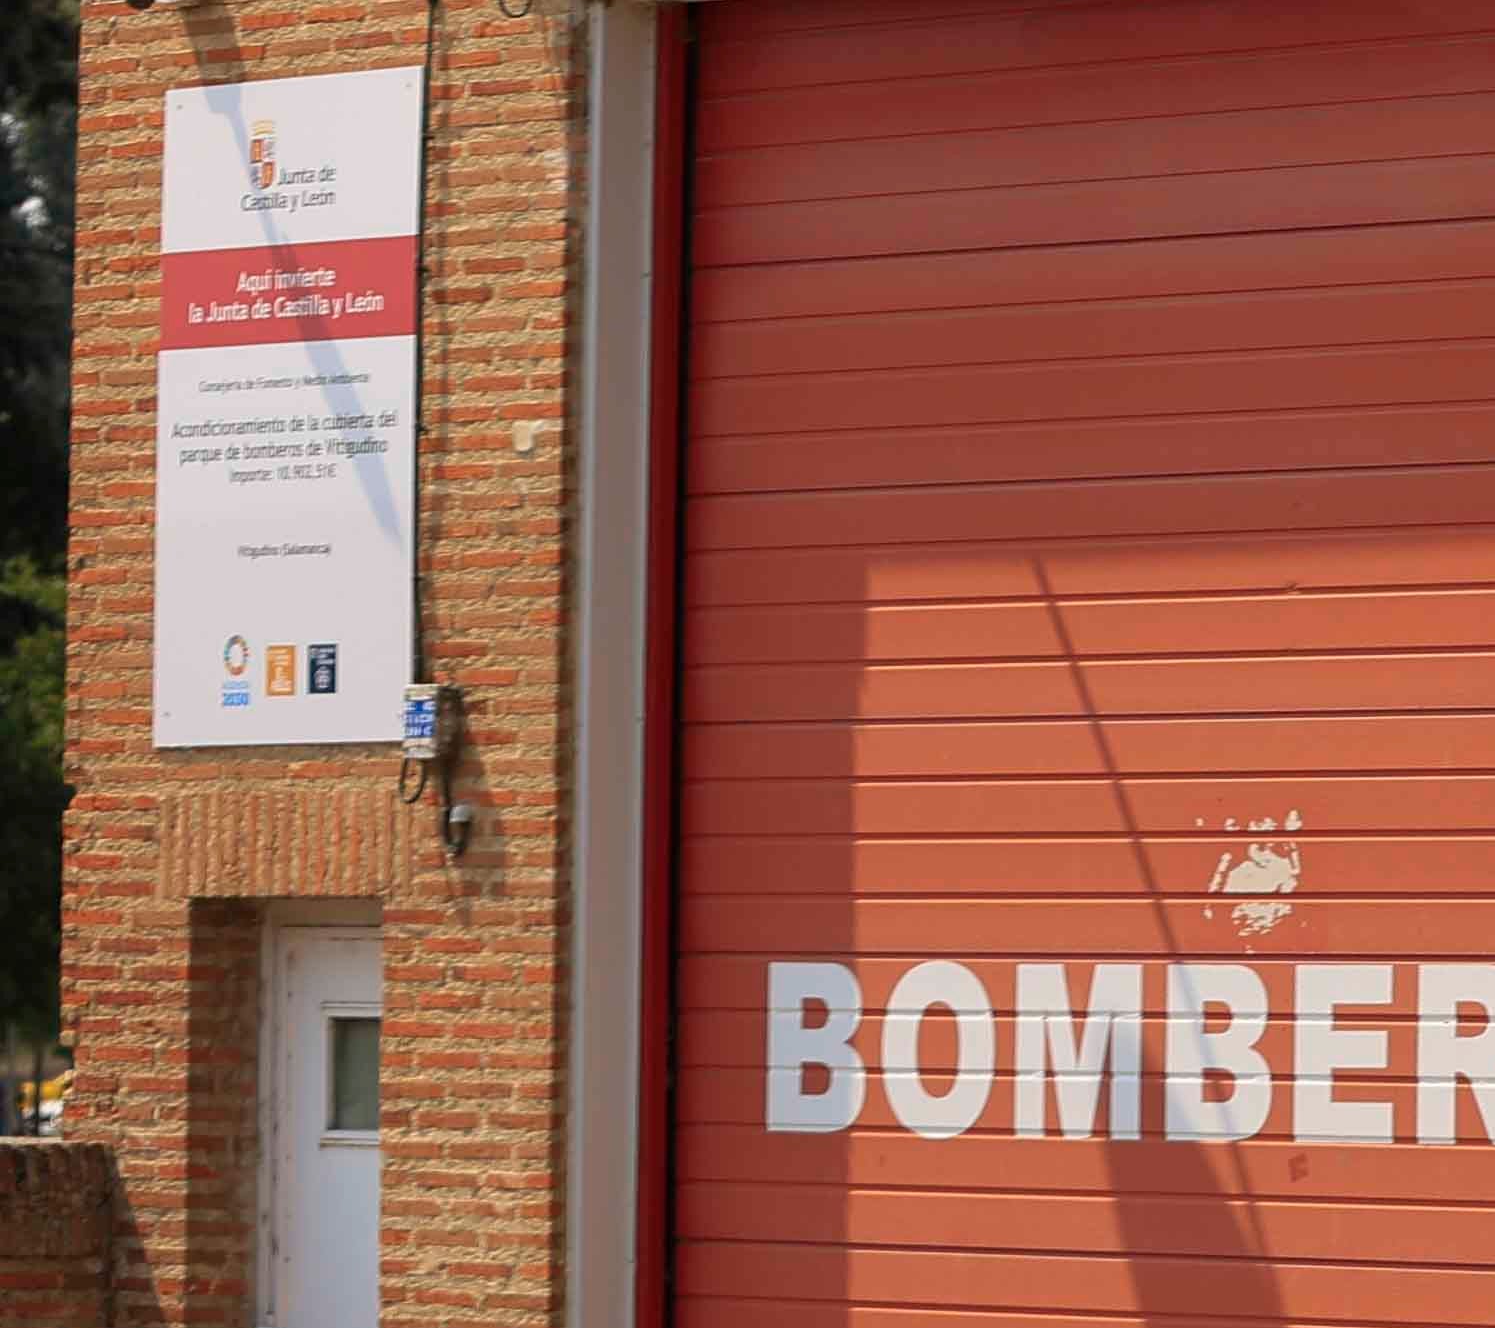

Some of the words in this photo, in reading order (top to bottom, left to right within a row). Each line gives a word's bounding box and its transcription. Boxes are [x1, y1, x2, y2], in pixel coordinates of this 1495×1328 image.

[318, 165, 336, 182] de
[289, 197, 299, 212] y
[236, 270, 272, 296] Aquí
[275, 267, 336, 290] invierte
[188, 302, 204, 324] la
[207, 301, 248, 322] Junta
[251, 298, 272, 319] de
[274, 293, 329, 319] Castilla
[331, 300, 344, 318] y
[345, 291, 385, 313] León
[289, 416, 305, 433] de
[225, 443, 240, 461] de
[306, 439, 322, 457] de
